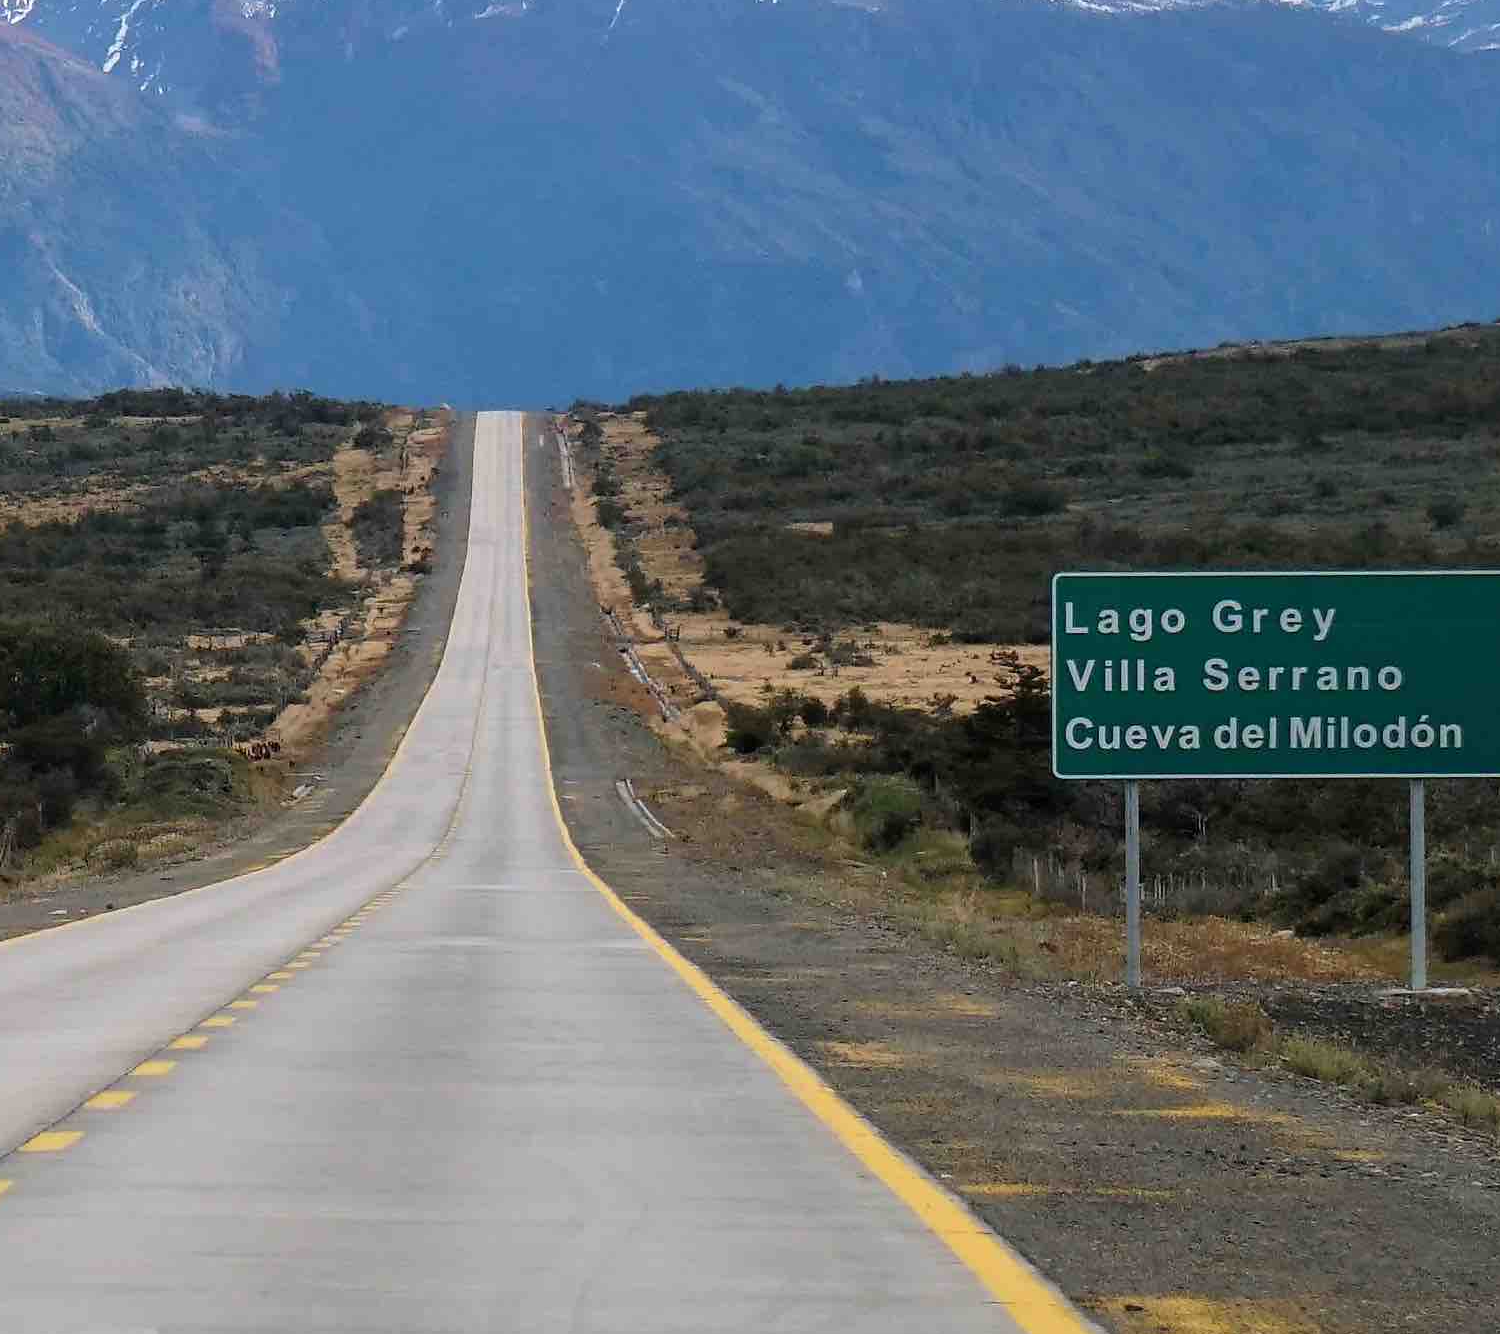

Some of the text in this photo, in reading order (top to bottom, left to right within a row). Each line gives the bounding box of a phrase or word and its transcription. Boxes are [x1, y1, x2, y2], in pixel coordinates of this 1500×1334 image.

[1065, 600, 1336, 641] Lago Grey
[1066, 658, 1403, 692] Villa Serrano
[1065, 714, 1463, 750] Cueva del Milodón
